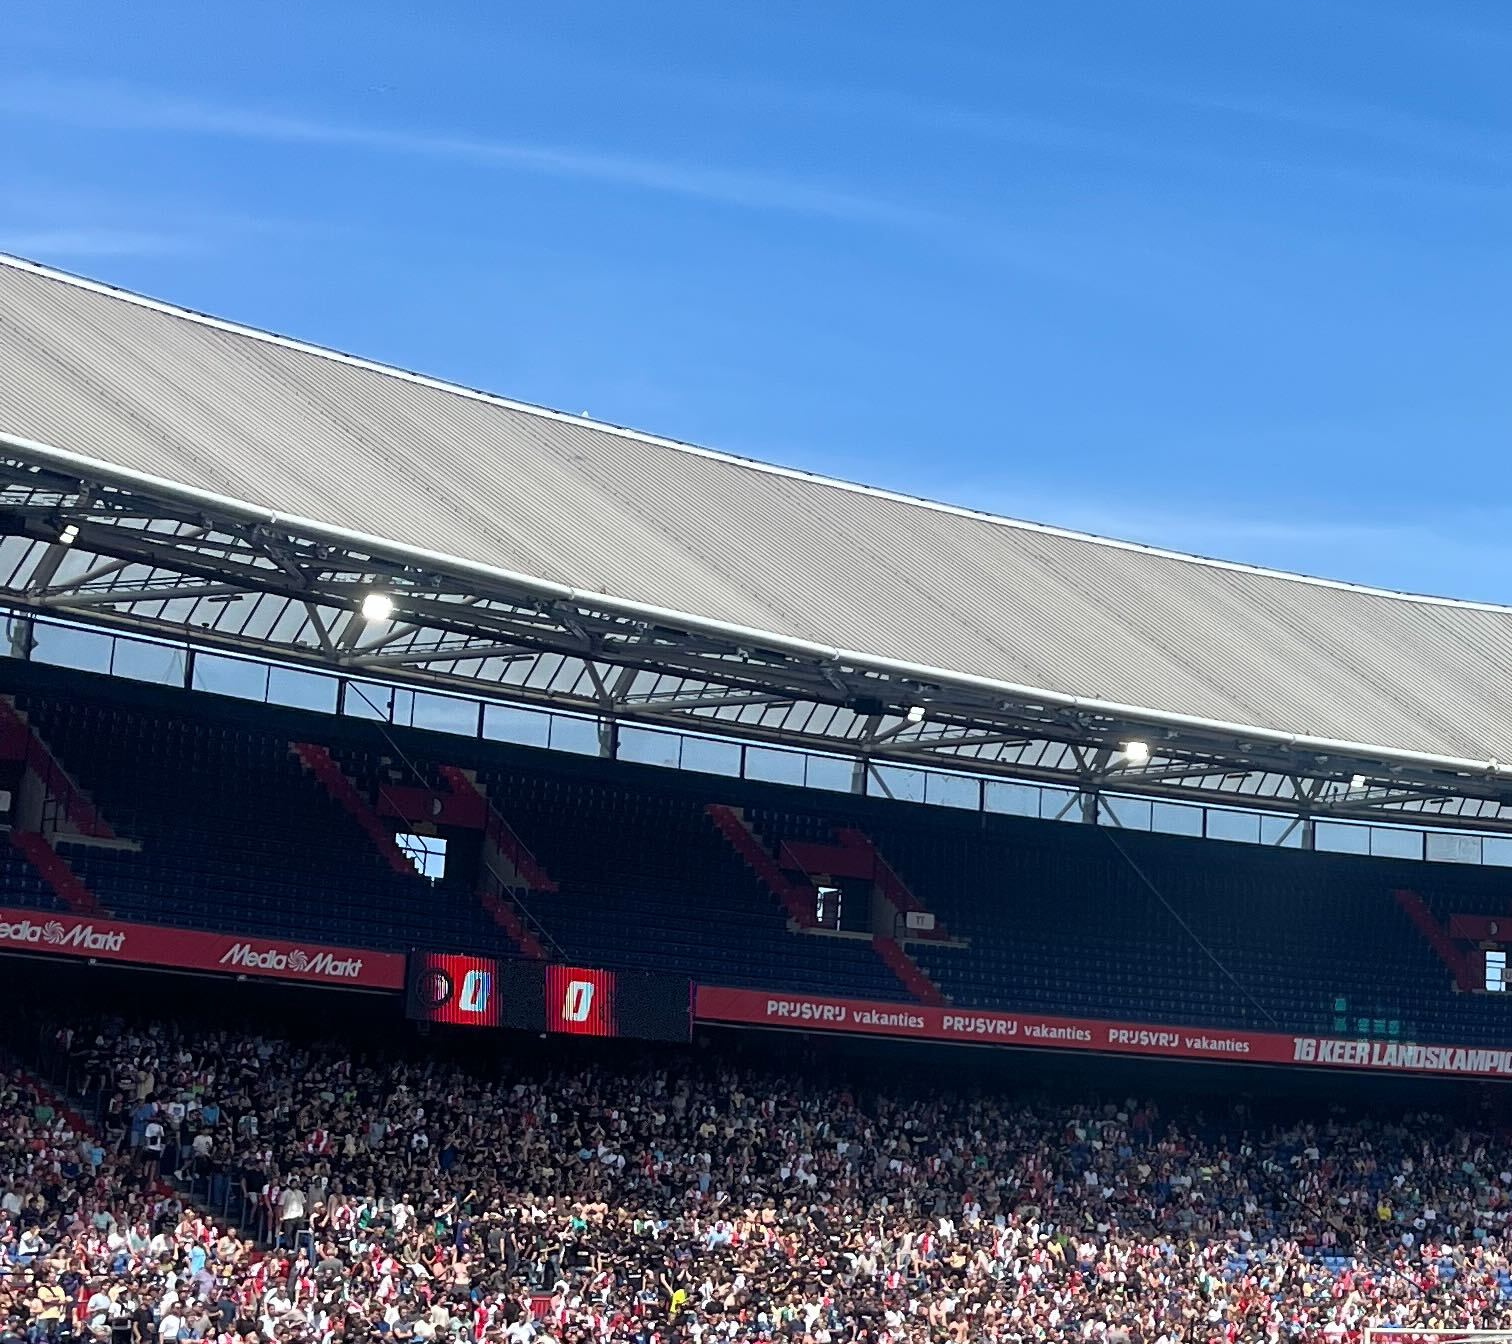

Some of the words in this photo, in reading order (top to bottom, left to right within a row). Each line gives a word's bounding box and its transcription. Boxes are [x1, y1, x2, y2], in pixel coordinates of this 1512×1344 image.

[0, 920, 42, 943] edia
[460, 969, 493, 1013] 0
[561, 979, 595, 1023] 0
[853, 1008, 925, 1030] vakanties
[1024, 1022, 1092, 1043] vakanties
[1185, 1034, 1251, 1054] vakanties
[1293, 1038, 1316, 1062] 16
[1318, 1040, 1371, 1066] KEER
